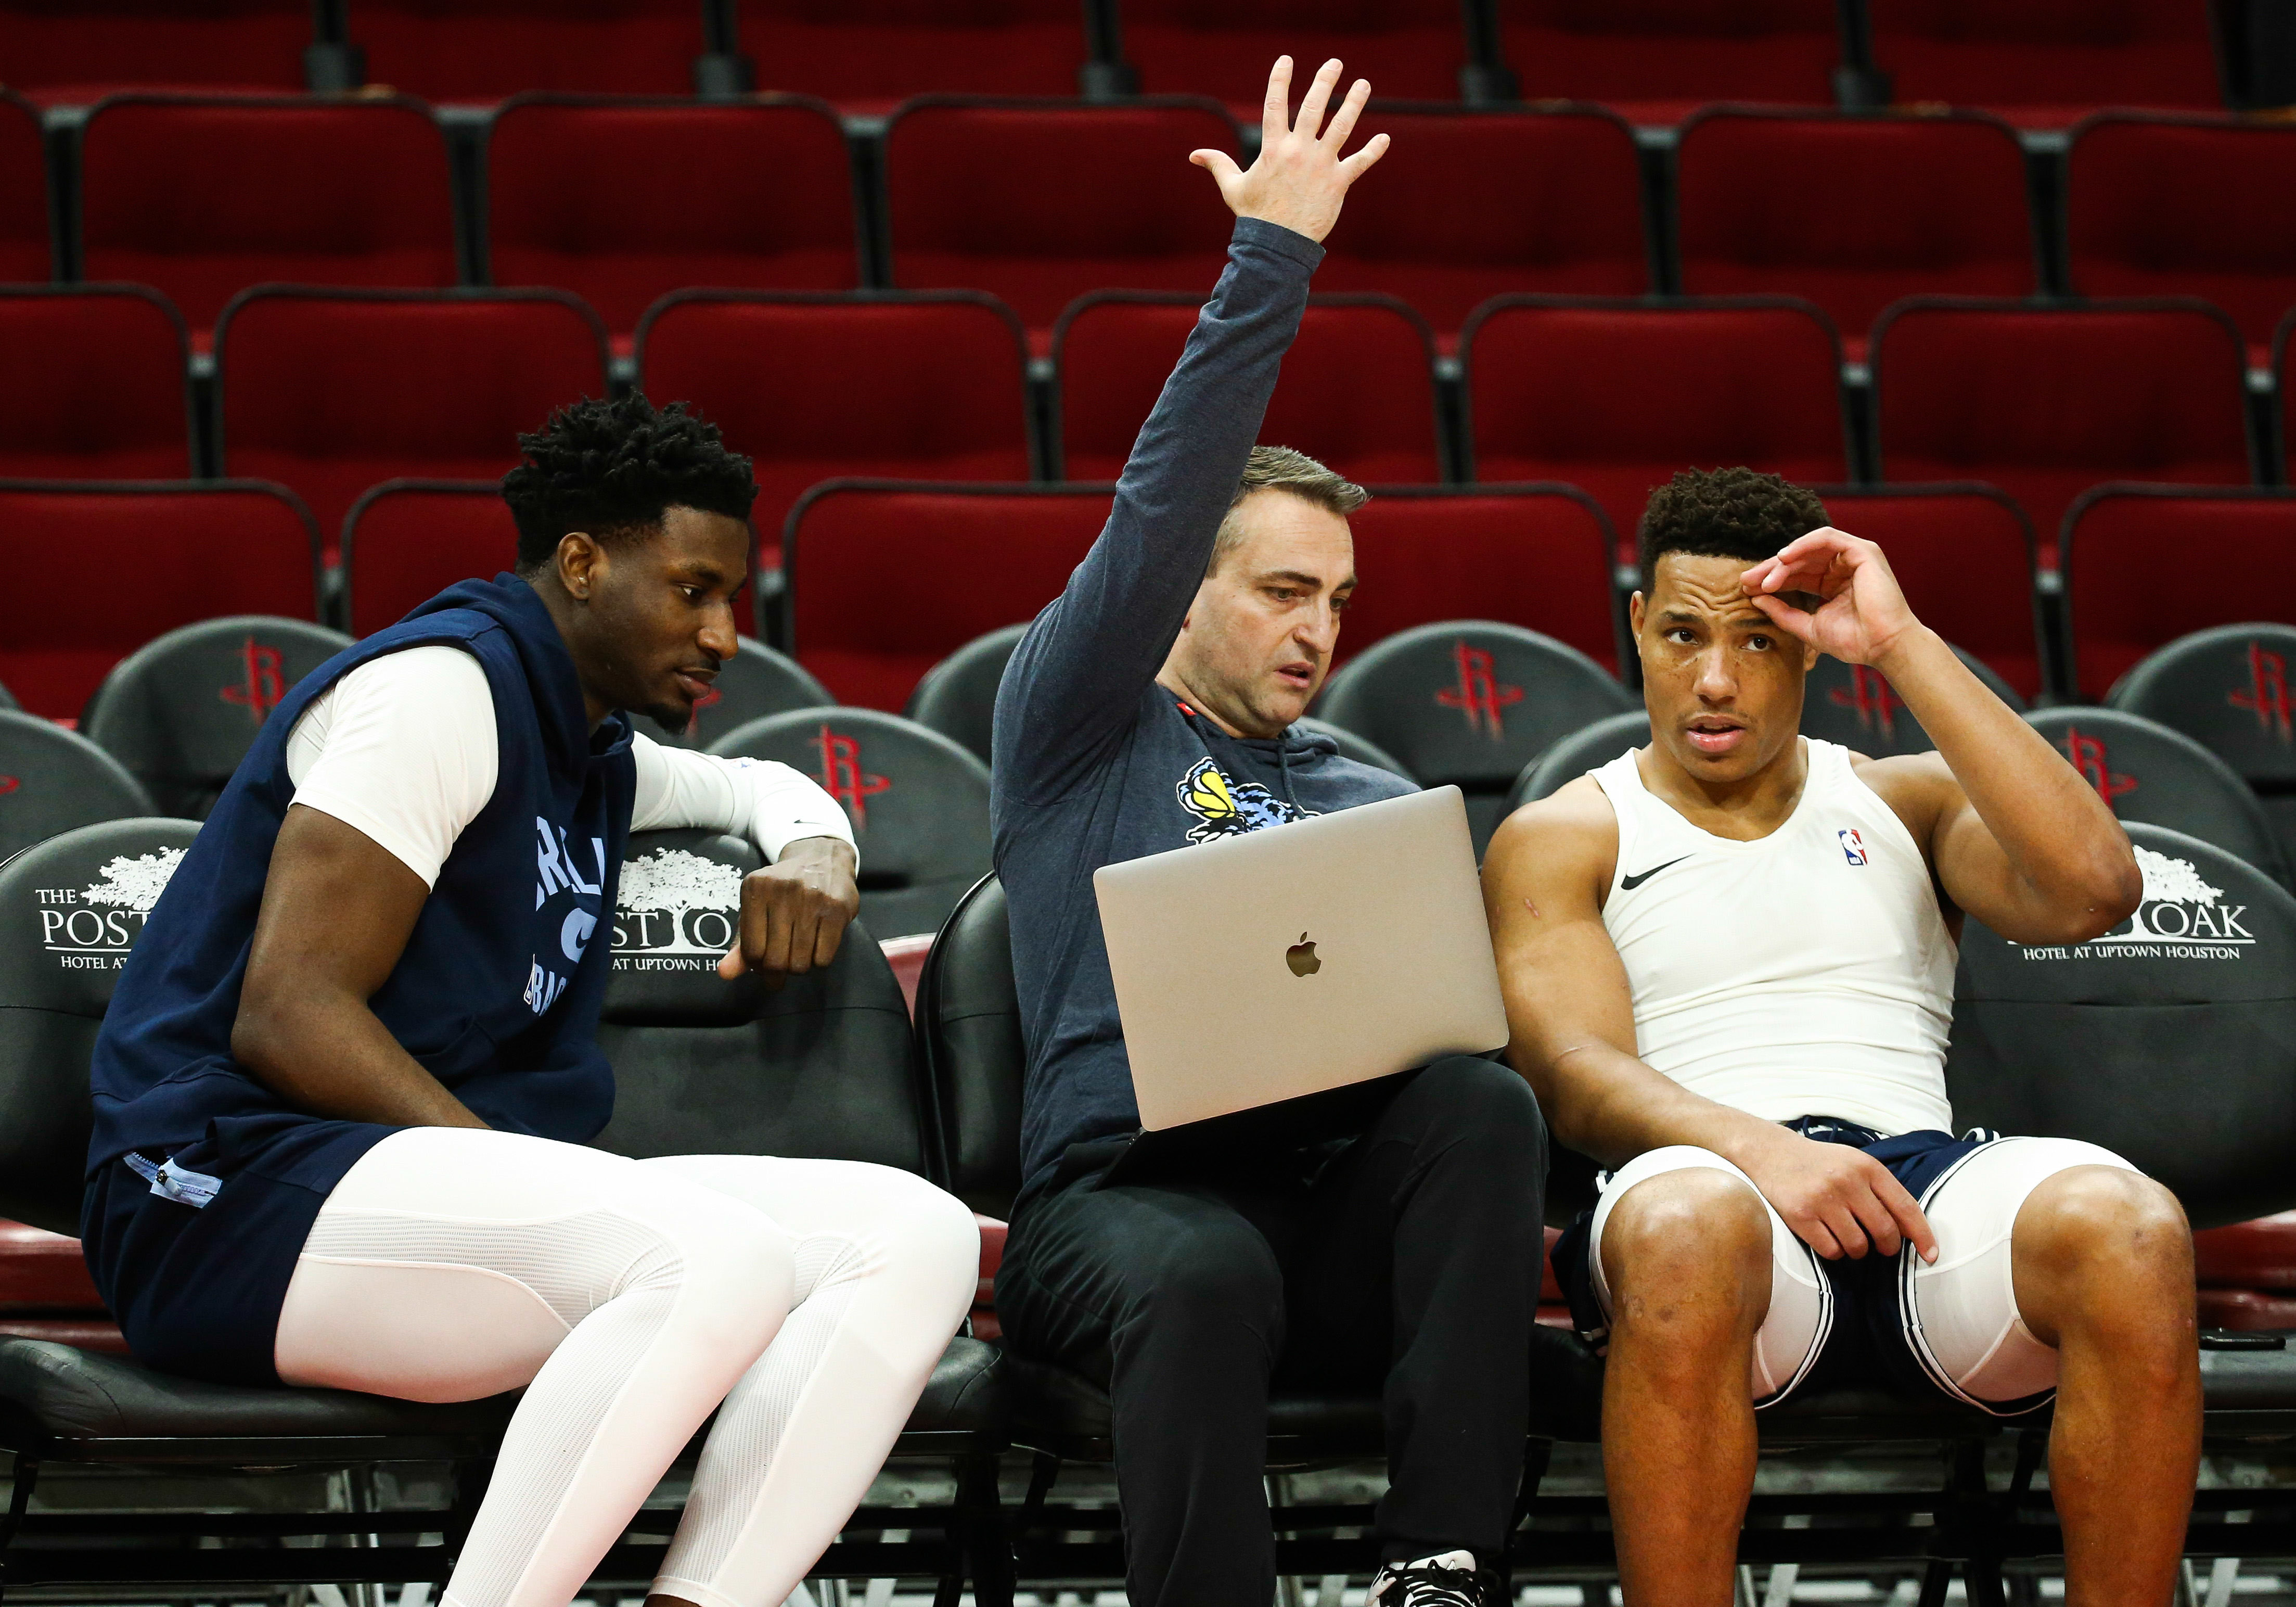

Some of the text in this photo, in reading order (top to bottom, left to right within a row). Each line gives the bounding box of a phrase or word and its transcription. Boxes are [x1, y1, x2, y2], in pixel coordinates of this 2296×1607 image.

[35, 889, 78, 904] THE
[2151, 903, 2253, 937] OAK
[2023, 945, 2240, 961] HOTEL AT UPTOWN HOUSTON
[60, 955, 108, 969] HOTEL
[612, 959, 723, 972] AT UPTOWN H
